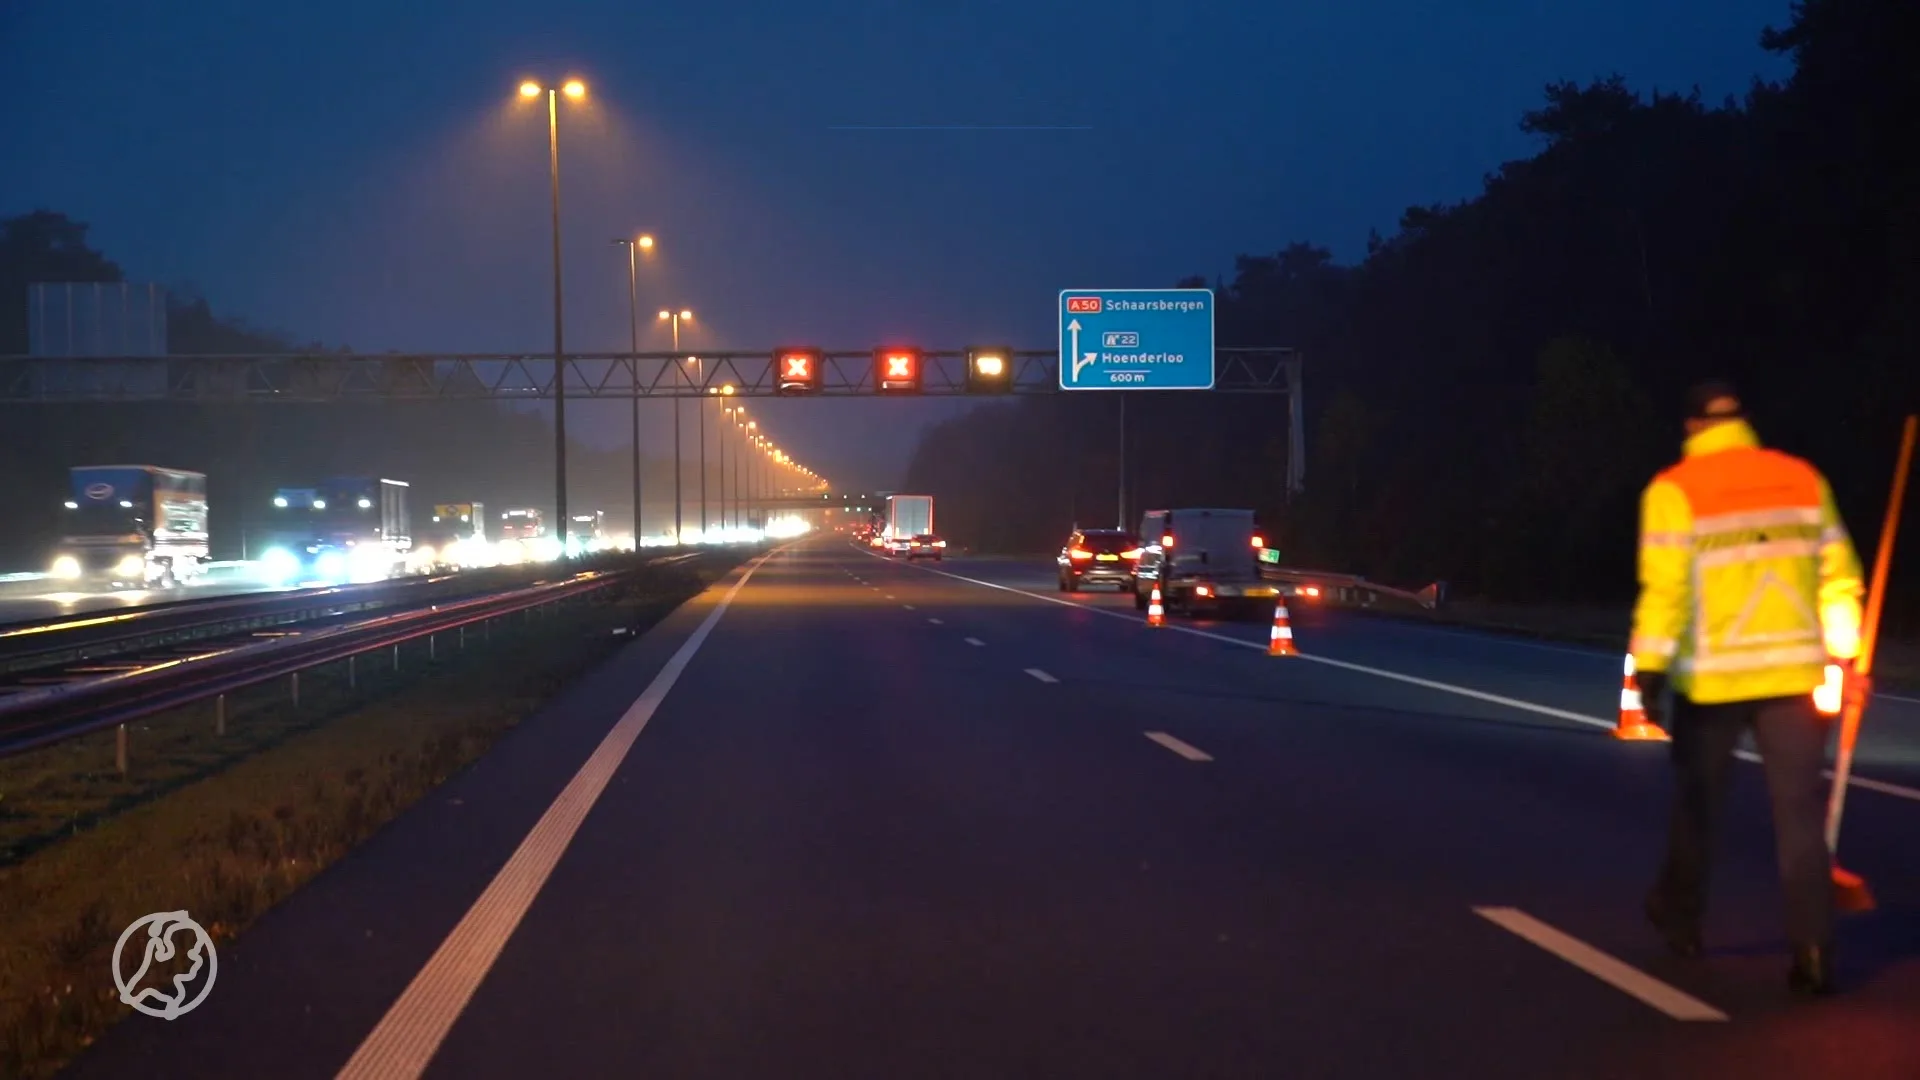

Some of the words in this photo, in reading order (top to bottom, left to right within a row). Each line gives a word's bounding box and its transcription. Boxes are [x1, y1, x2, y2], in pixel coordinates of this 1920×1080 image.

[1106, 299, 1204, 313] Schaarsbergen
[1121, 336, 1137, 345] 22
[1102, 353, 1184, 364] Hoenderloo
[1110, 373, 1133, 382] 600
